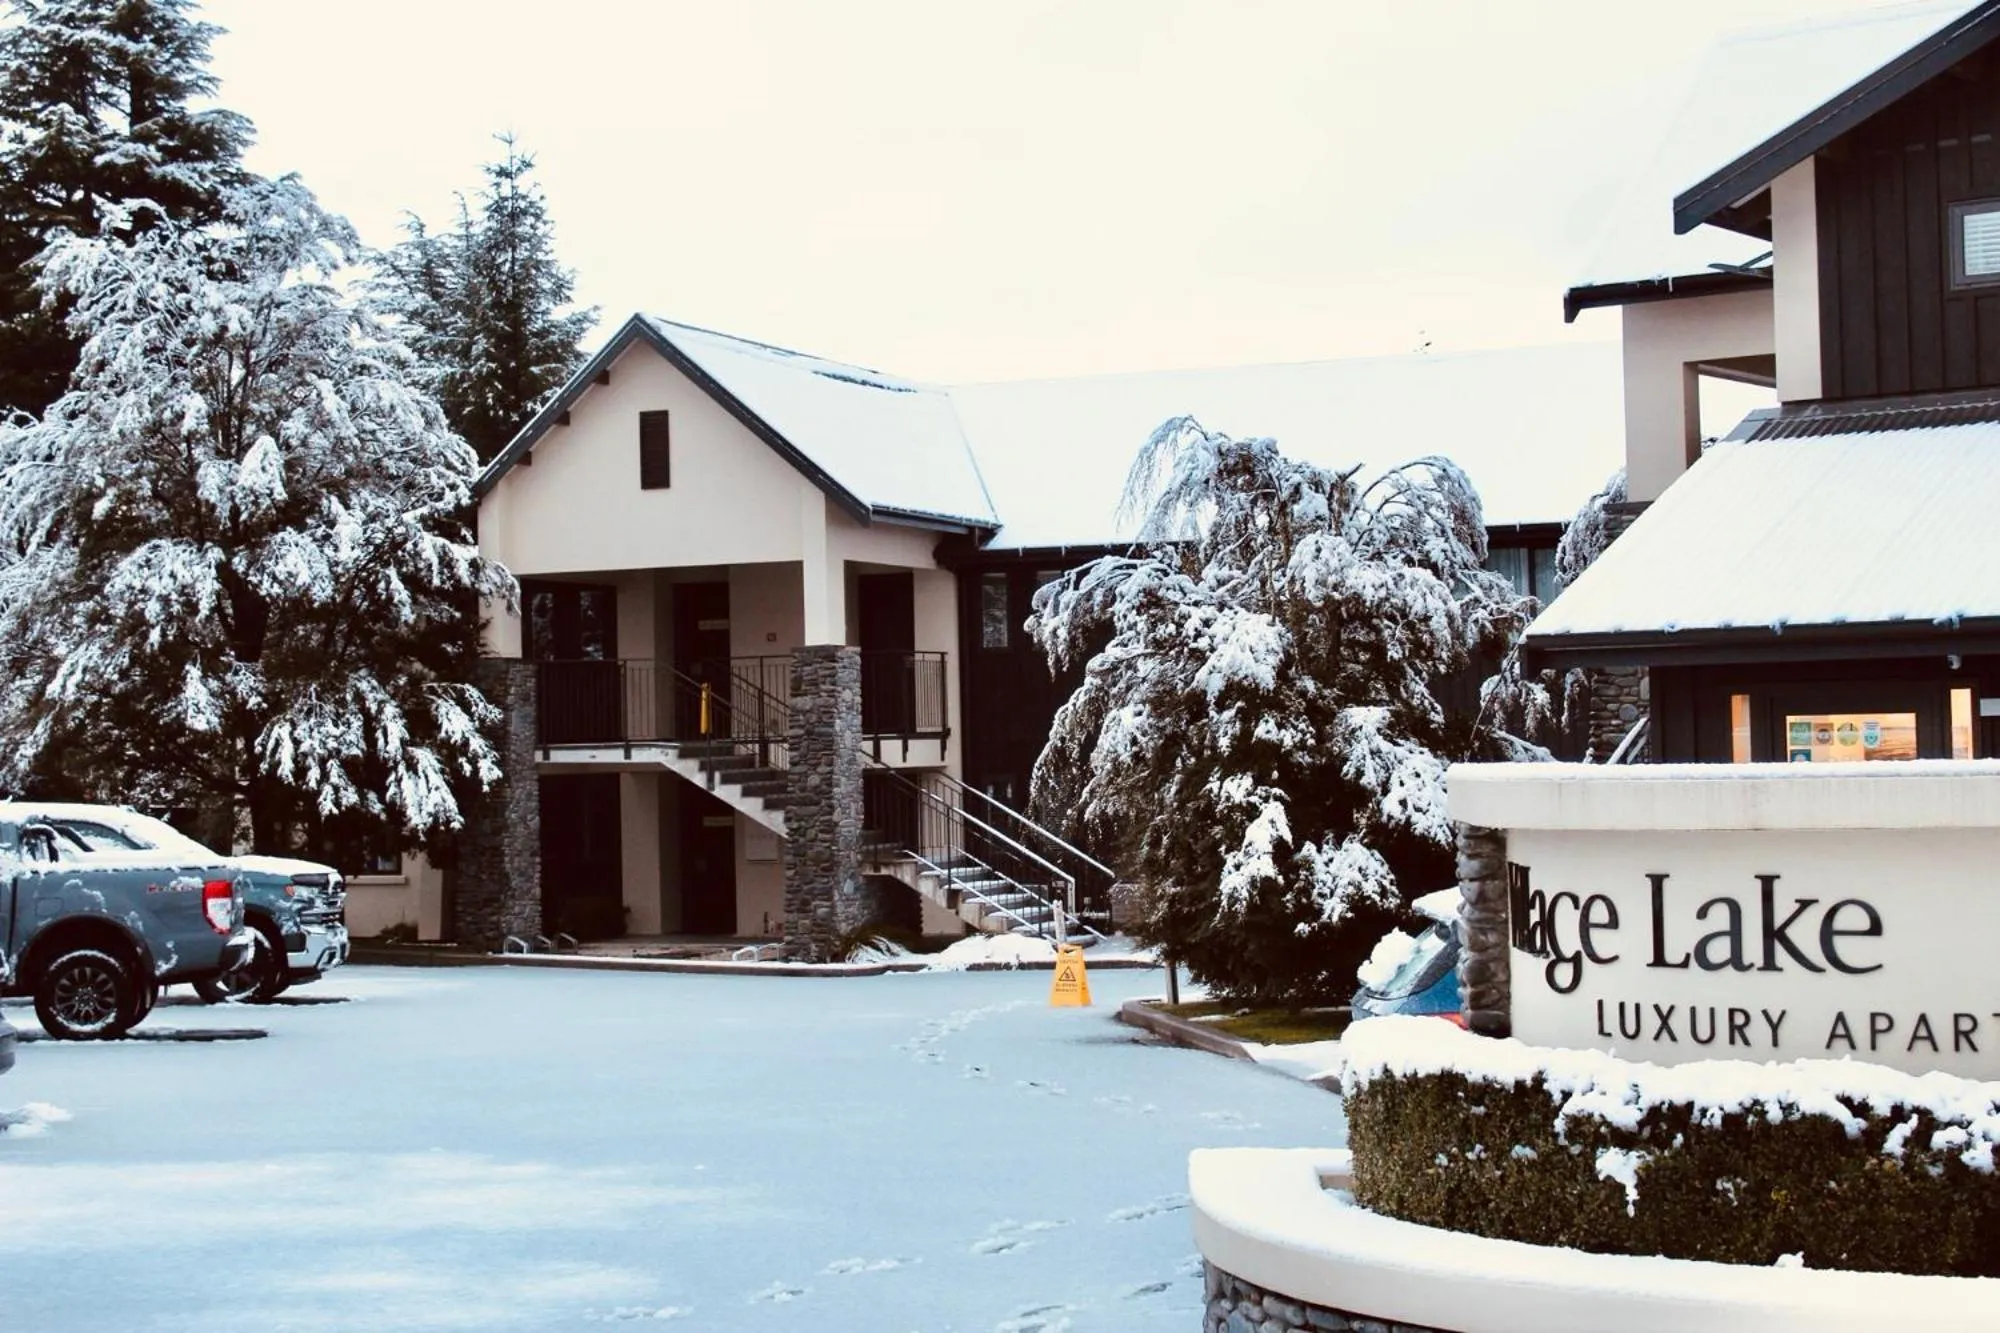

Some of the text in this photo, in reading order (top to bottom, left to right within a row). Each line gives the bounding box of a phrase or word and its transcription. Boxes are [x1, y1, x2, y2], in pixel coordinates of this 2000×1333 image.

[1645, 873, 1884, 974] Lake
[1597, 998, 2000, 1053] LUXURY APAR
